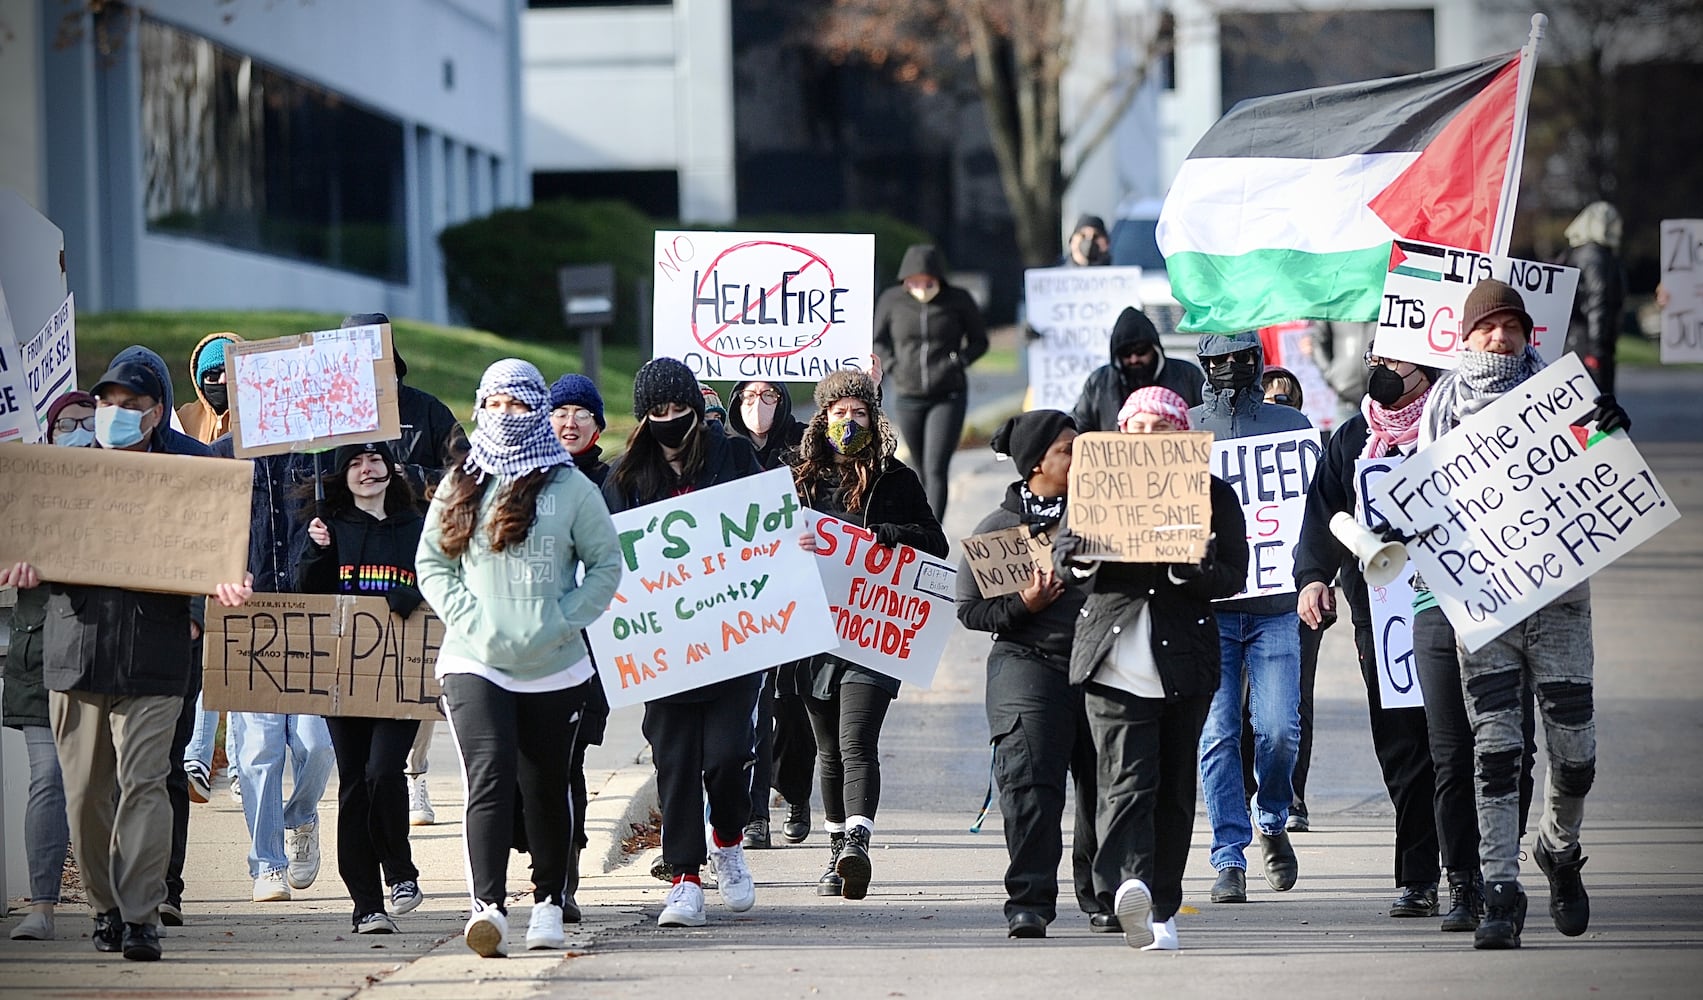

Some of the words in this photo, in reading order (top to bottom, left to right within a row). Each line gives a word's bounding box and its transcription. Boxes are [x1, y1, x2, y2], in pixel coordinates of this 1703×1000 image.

[658, 236, 694, 281] NO
[1444, 250, 1493, 284] ITS
[1509, 261, 1564, 294] NOT
[692, 270, 849, 326] HELLFIRE
[1053, 303, 1109, 321] STOP
[1380, 294, 1425, 329] ITS
[27, 332, 43, 364] FROM
[44, 323, 53, 343] THE
[54, 302, 69, 333] RIVER
[715, 334, 822, 351] MISSILES
[1041, 327, 1111, 350] FUNDIN
[28, 366, 40, 393] TO
[41, 347, 54, 384] THE
[56, 330, 71, 366] SEA
[684, 353, 721, 377] ON
[1081, 440, 1157, 468] AMERICA
[1161, 440, 1209, 466] BACKS
[1388, 454, 1477, 521] From
[1466, 425, 1518, 468] the
[1518, 374, 1584, 433] river
[1076, 471, 1137, 499] ISRAEL
[1147, 471, 1180, 499] B/C
[1185, 472, 1209, 496] WE
[1414, 523, 1450, 553] to
[1444, 486, 1503, 532] the
[1507, 434, 1578, 492] sea
[1074, 503, 1107, 524] DID
[1114, 504, 1148, 526] THE
[1153, 503, 1201, 526] SAME
[618, 509, 697, 572] T'S
[813, 517, 917, 585] STOP
[963, 540, 990, 560] NO
[1156, 546, 1189, 557] NOW
[1465, 567, 1523, 623] will
[1516, 553, 1562, 588] be
[1556, 469, 1667, 566] FREE!
[640, 564, 693, 593] WAR
[702, 553, 726, 575] IF
[977, 567, 1003, 589] NO
[613, 611, 662, 640] ONE
[615, 647, 668, 689] HAS
[686, 643, 711, 664] AN
[722, 601, 796, 652] ARMY
[223, 612, 331, 695] FREE
[350, 611, 447, 712] PALE
